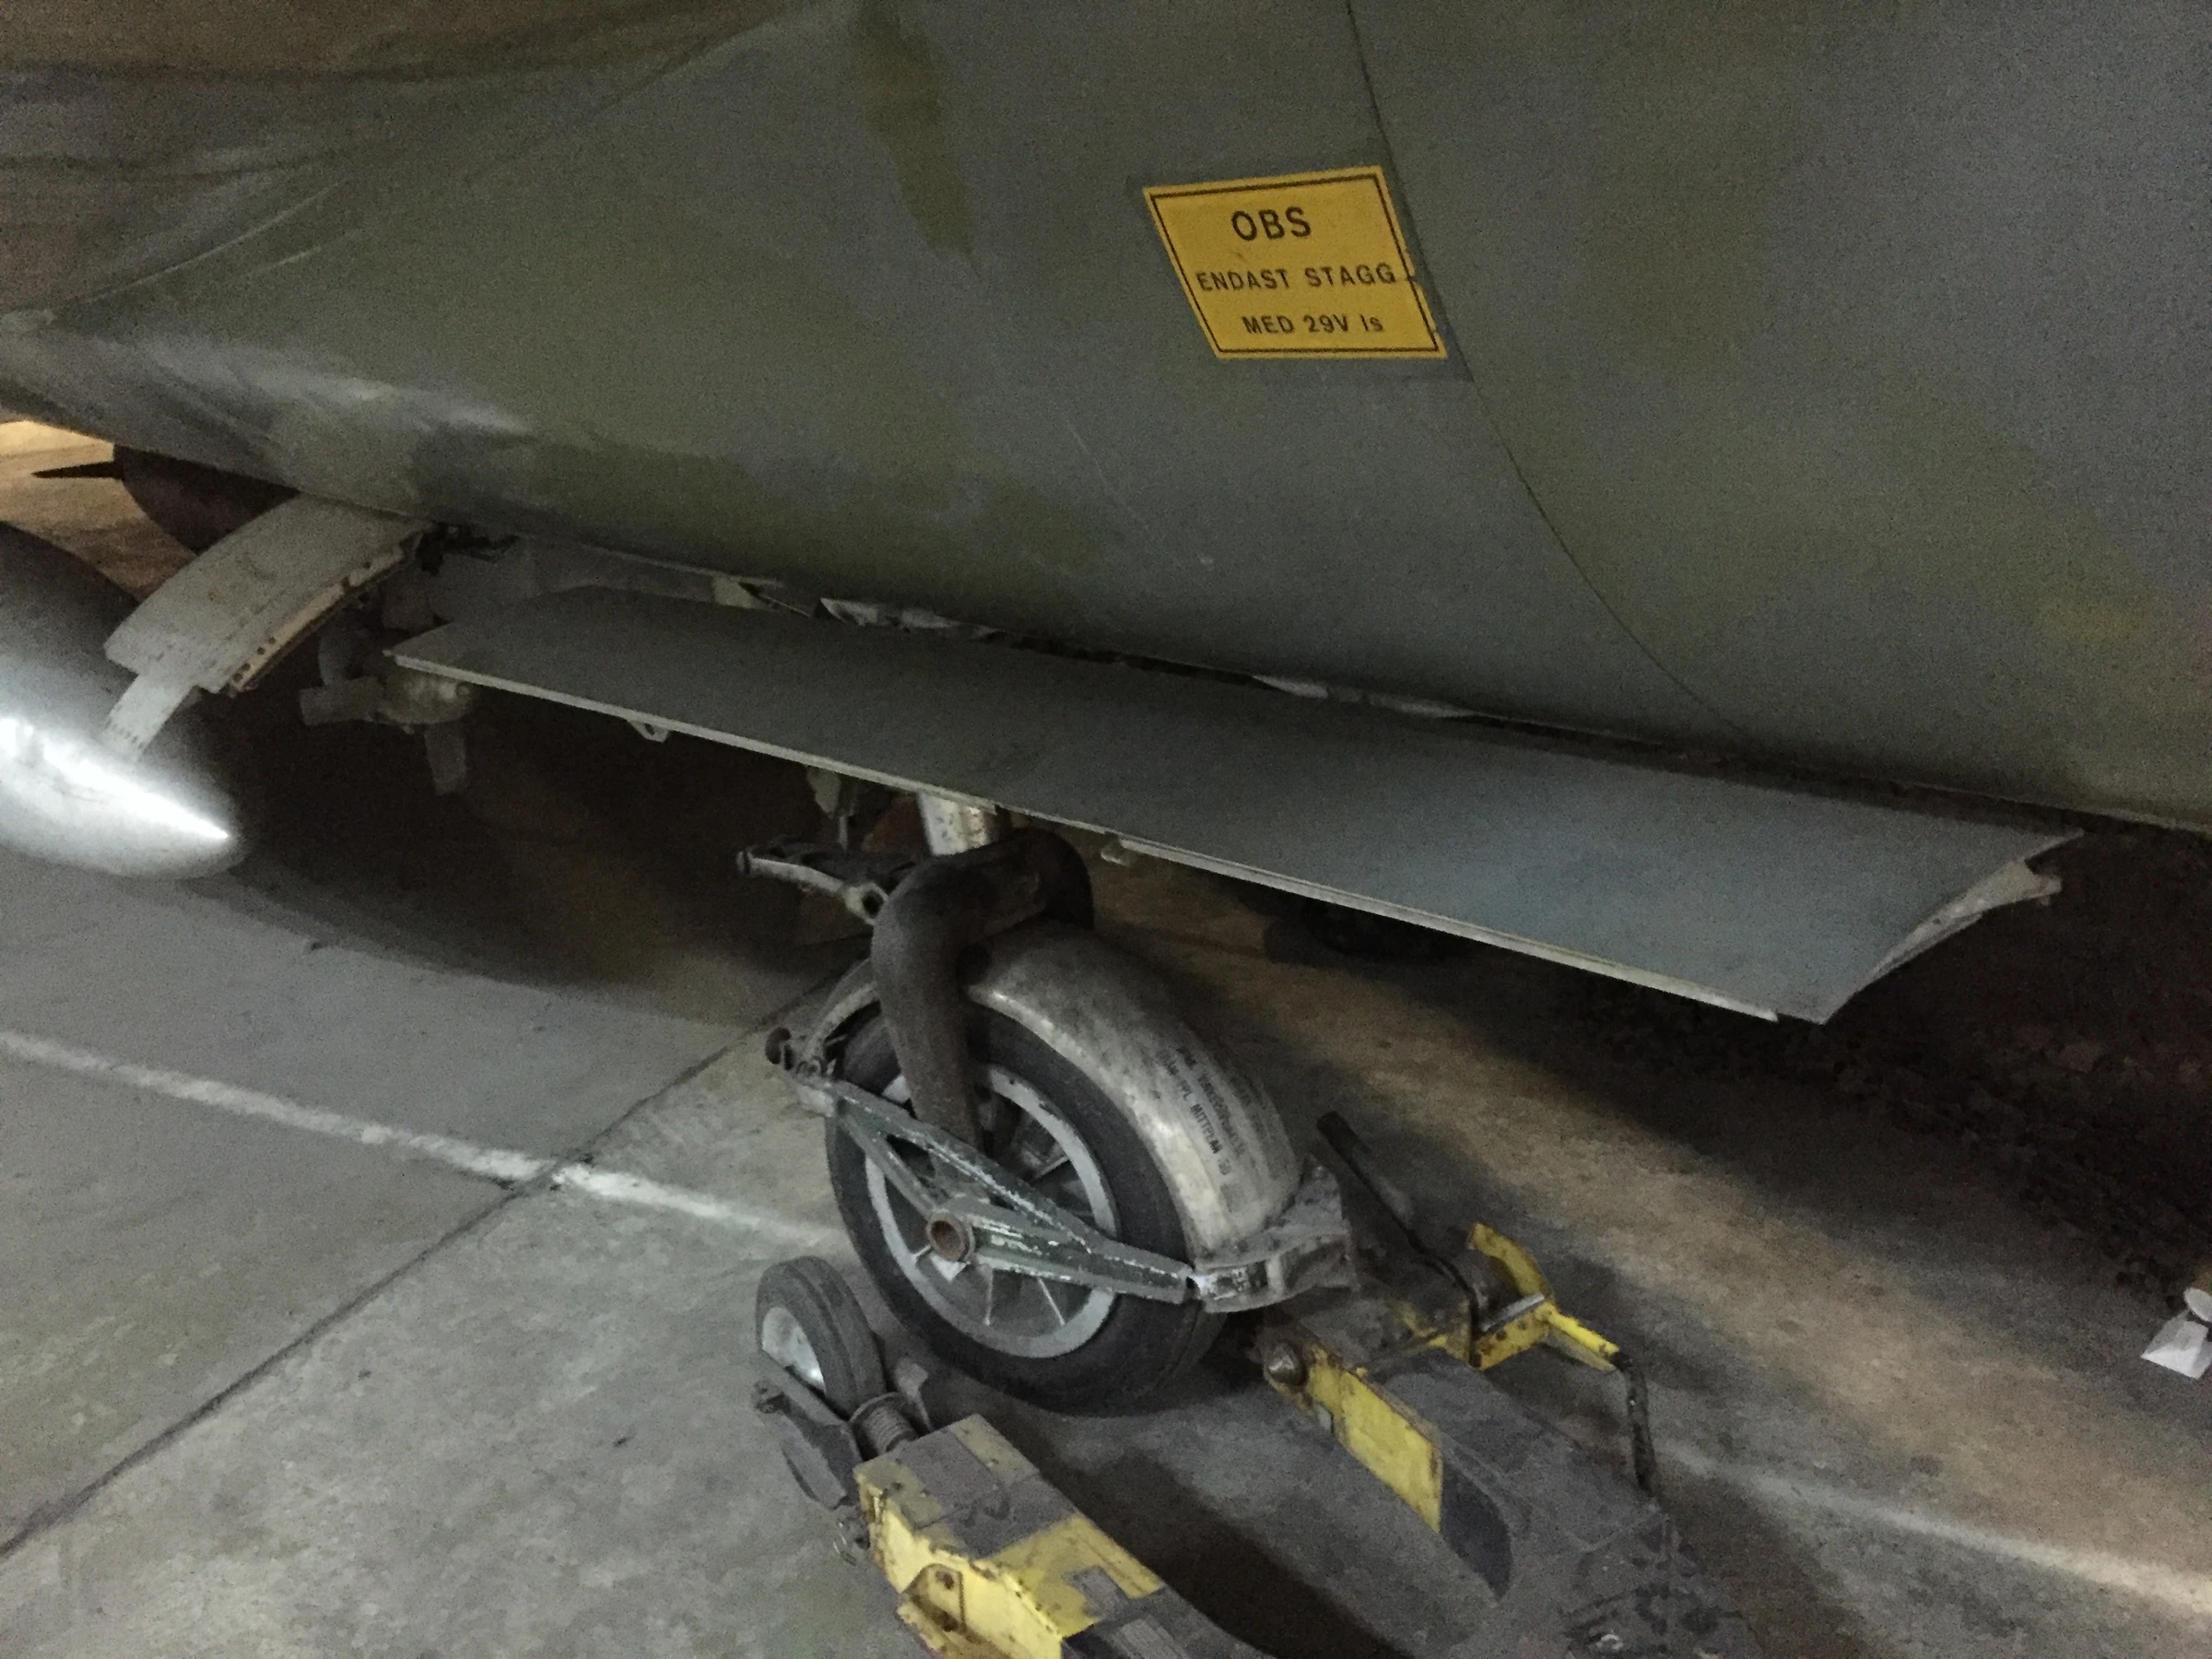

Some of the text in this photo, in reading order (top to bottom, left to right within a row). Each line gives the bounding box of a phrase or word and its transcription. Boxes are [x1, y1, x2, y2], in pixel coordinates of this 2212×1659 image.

[1231, 206, 1312, 241] OBS
[1195, 268, 1290, 291] ENDAST
[1241, 314, 1295, 334] MED
[1303, 312, 1349, 334] 29V
